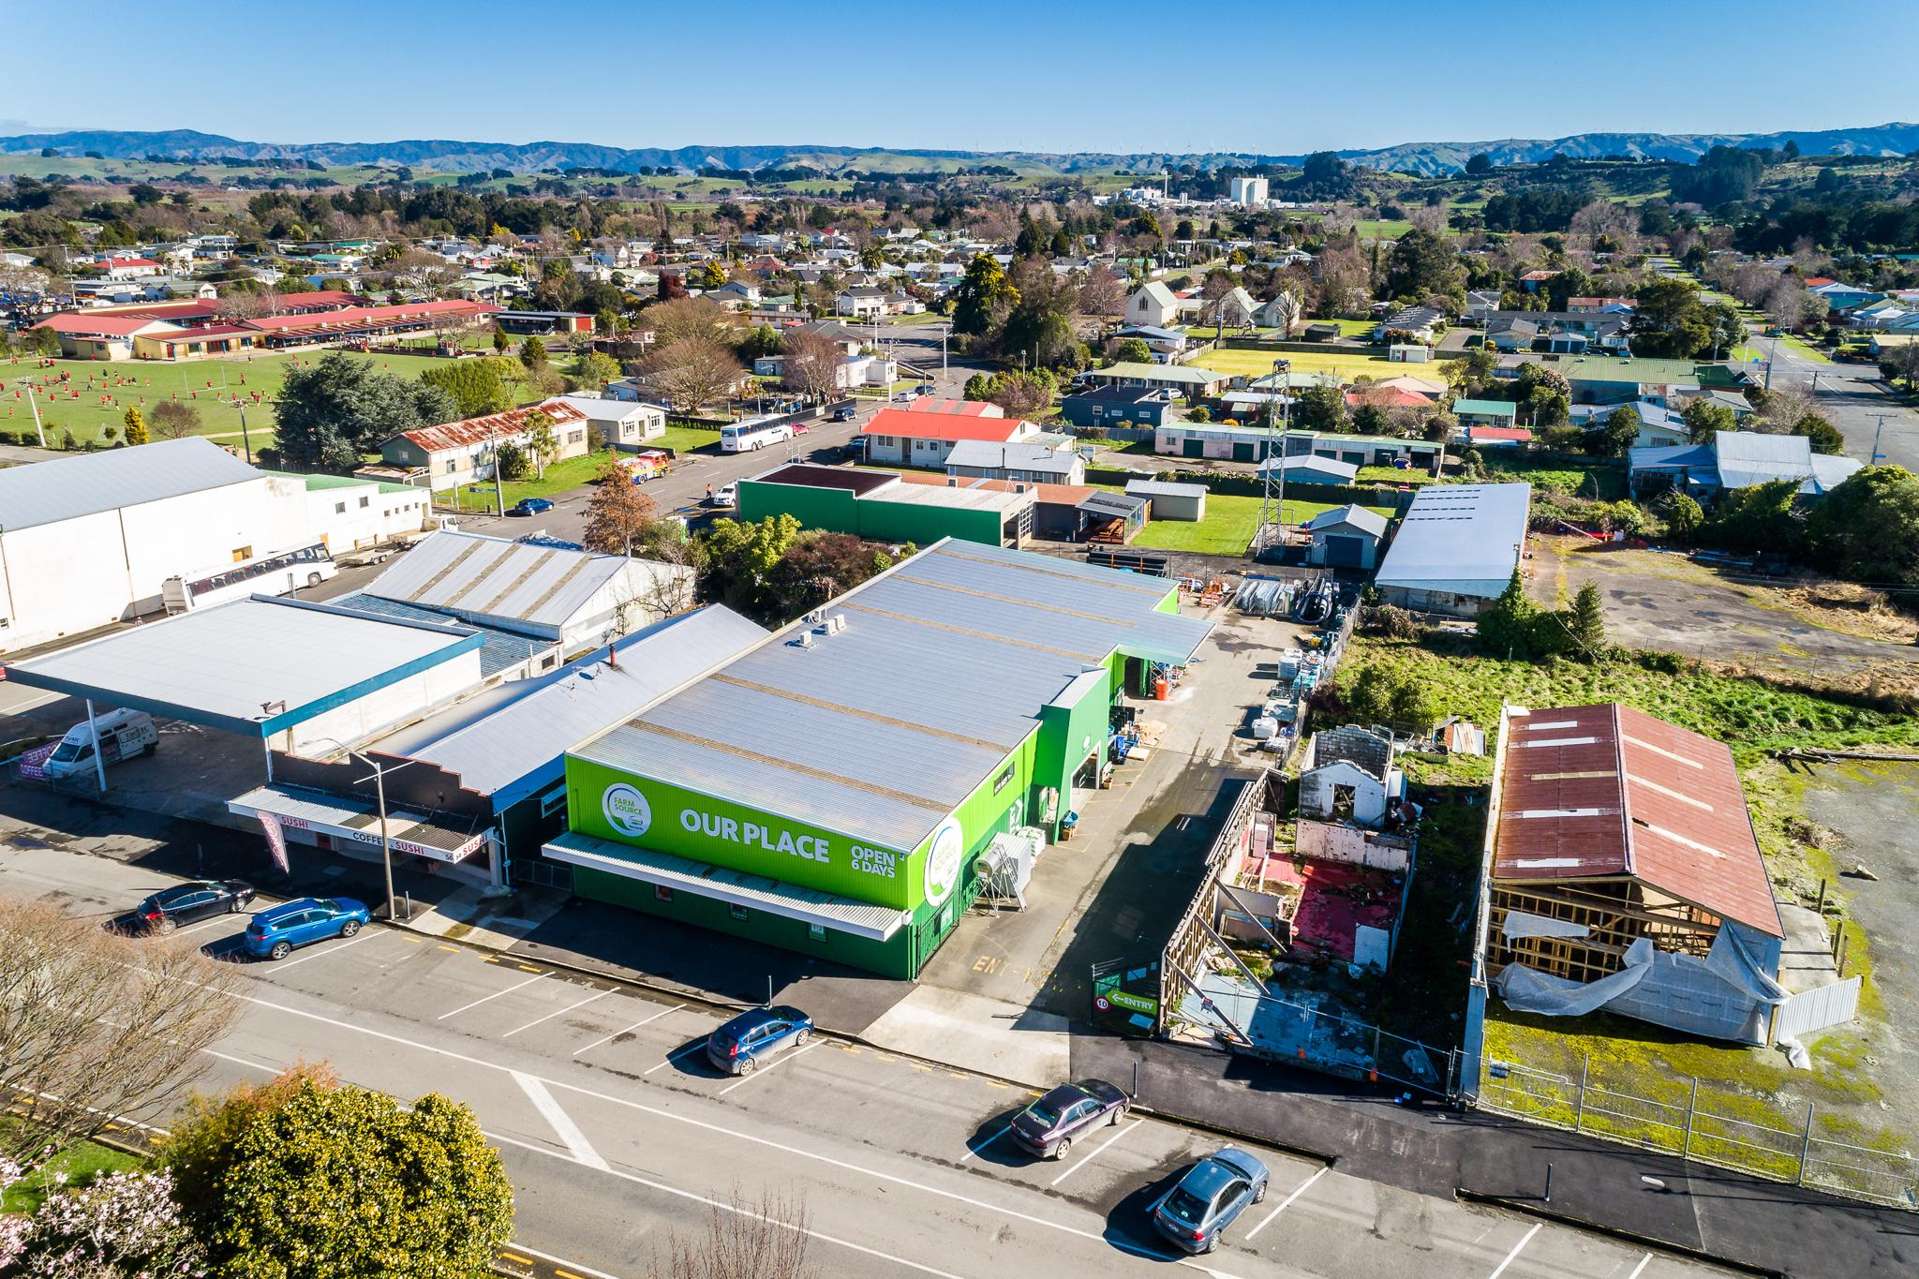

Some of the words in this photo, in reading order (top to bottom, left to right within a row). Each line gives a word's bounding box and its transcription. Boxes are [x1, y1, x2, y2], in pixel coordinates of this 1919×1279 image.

[615, 804, 642, 816] SOURCE
[281, 816, 308, 829] SUSHI
[353, 832, 386, 846] COFFE
[395, 841, 425, 855] SUSHI
[464, 833, 488, 856] SUSHI
[680, 808, 738, 843] OUR
[744, 823, 830, 863] PLACE
[850, 845, 895, 867] OPEN
[851, 858, 860, 871] 6
[861, 860, 895, 879] DAYS
[1124, 998, 1153, 1010] ENTRY
